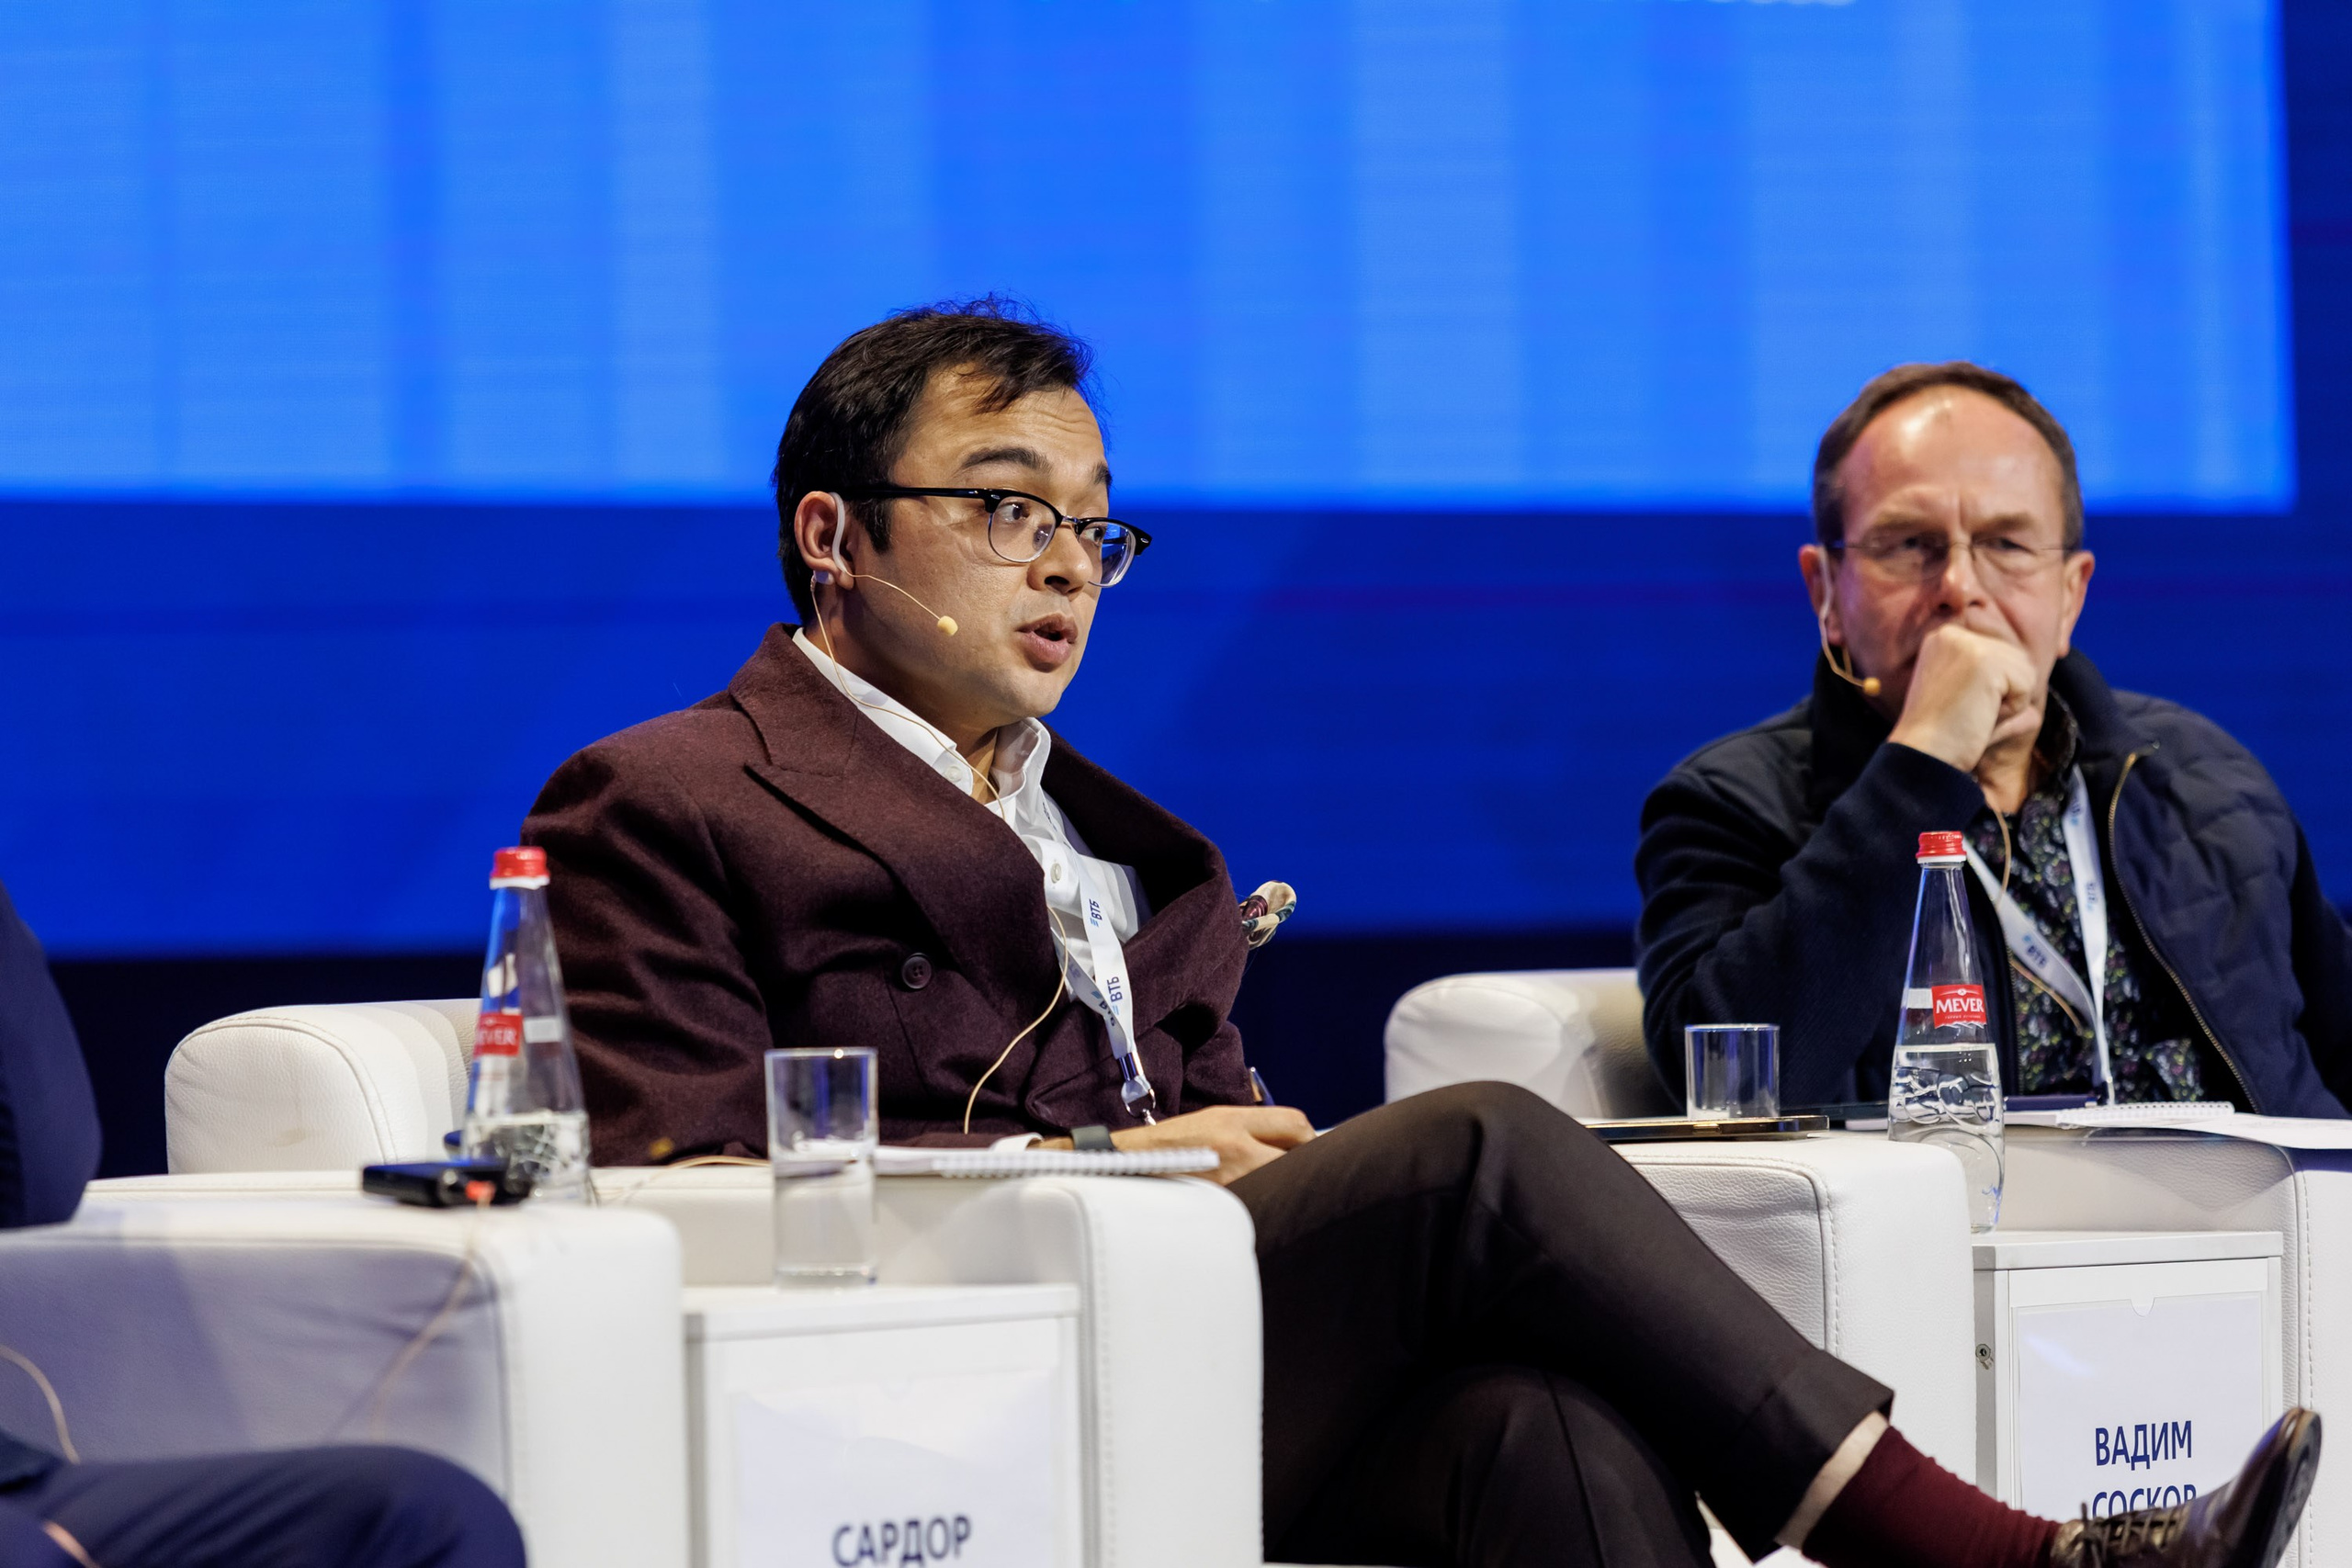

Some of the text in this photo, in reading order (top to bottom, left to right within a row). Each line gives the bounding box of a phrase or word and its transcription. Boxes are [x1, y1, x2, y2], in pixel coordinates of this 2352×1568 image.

[1089, 897, 1102, 920] ВТБ
[1107, 976, 1123, 1002] ВТБ
[1936, 998, 1984, 1014] MEVER
[474, 1027, 517, 1046] EVER
[2095, 1420, 2193, 1471] ВАДИМ
[831, 1516, 971, 1568] САРДОР
